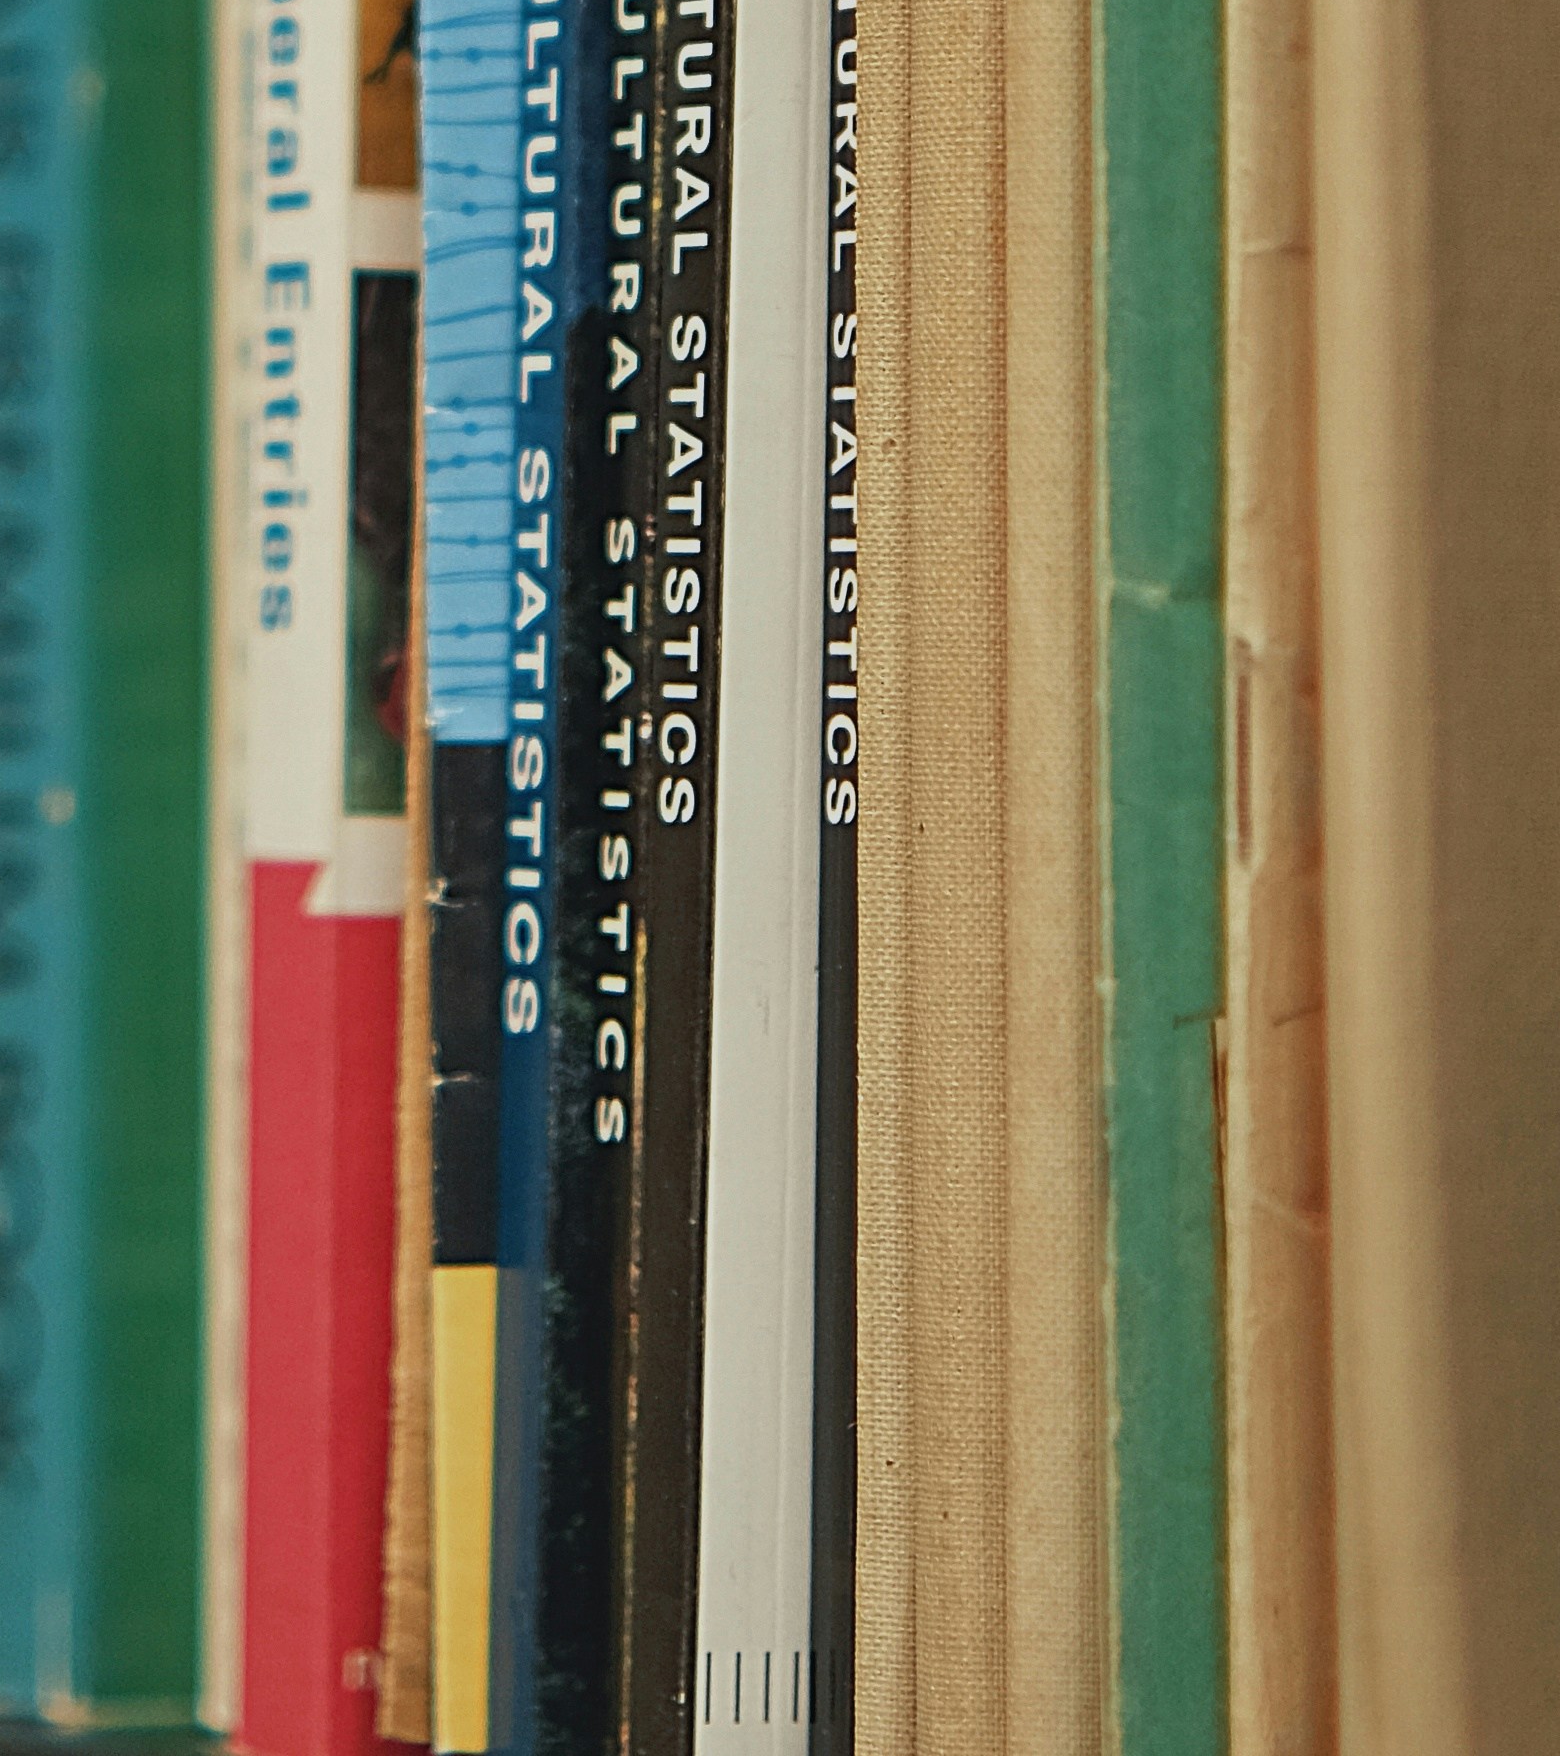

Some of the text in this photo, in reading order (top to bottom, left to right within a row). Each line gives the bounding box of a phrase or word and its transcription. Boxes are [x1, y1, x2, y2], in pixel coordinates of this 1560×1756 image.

[258, 259, 314, 634] Entries
[658, 313, 709, 825] STATISTICS
[505, 447, 552, 1036] STATISTICS
[597, 517, 637, 1144] STATISTICS
